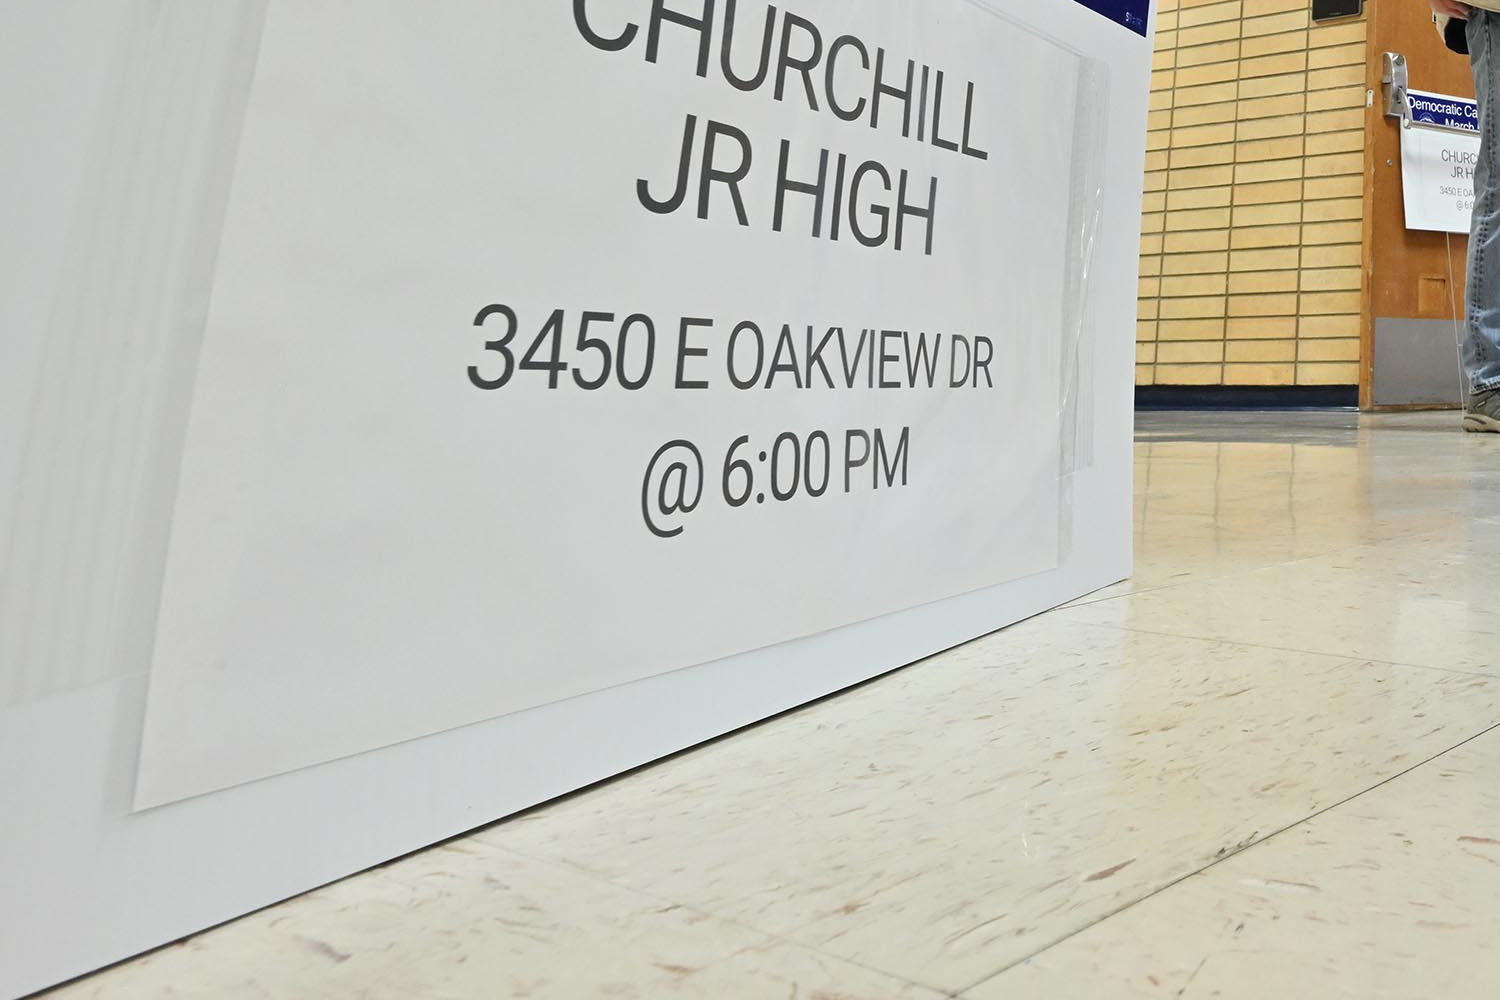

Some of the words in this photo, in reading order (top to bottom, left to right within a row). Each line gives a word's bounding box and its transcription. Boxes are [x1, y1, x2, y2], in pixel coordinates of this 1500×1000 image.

[1407, 96, 1463, 116] Democratic
[1441, 149, 1478, 165] CHURC
[1451, 166, 1464, 178] JR
[636, 114, 753, 228] JR
[772, 138, 938, 255] HIGH
[466, 303, 657, 391] 3450
[674, 316, 714, 390] E
[726, 319, 942, 391] OAKVIEW
[949, 333, 994, 389] DR
[641, 439, 704, 539] @
[722, 429, 831, 508] 6:00
[843, 426, 911, 493] PM
